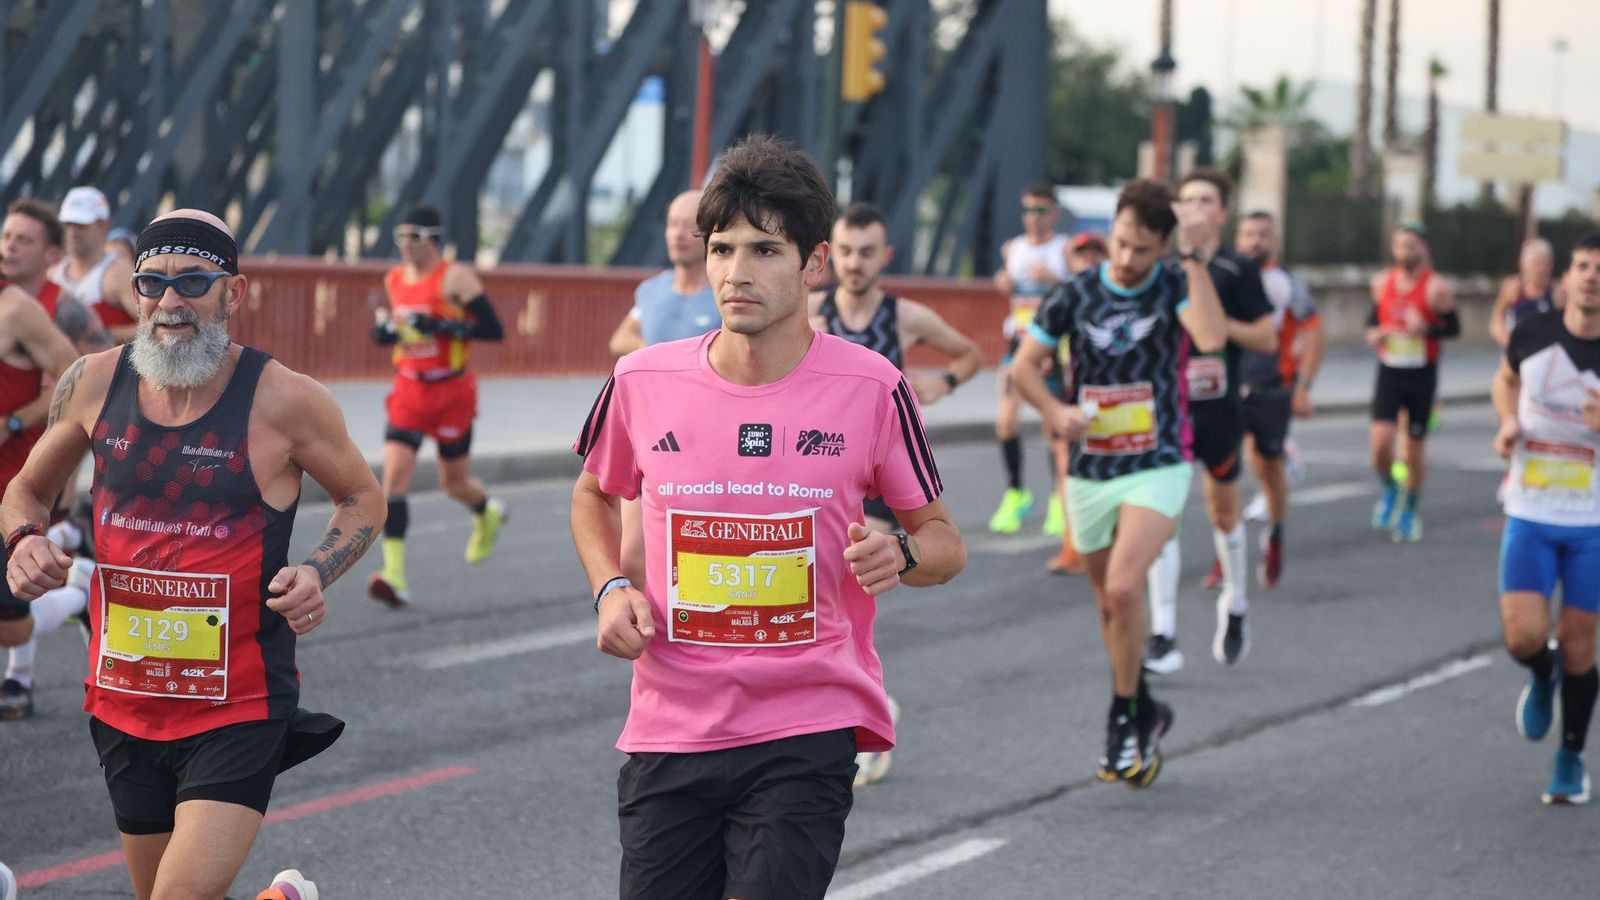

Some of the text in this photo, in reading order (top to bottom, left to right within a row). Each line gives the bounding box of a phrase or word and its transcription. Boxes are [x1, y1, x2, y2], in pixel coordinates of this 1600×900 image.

[745, 437, 765, 449] Spin
[657, 481, 834, 498] all roads lead to Rome
[709, 520, 804, 542] GENERALI
[708, 563, 777, 587] 5317
[130, 576, 218, 598] GENERALI
[728, 590, 758, 599] SANTI
[769, 613, 796, 624] 42K
[128, 615, 189, 641] 2129
[181, 668, 206, 678] 42K
